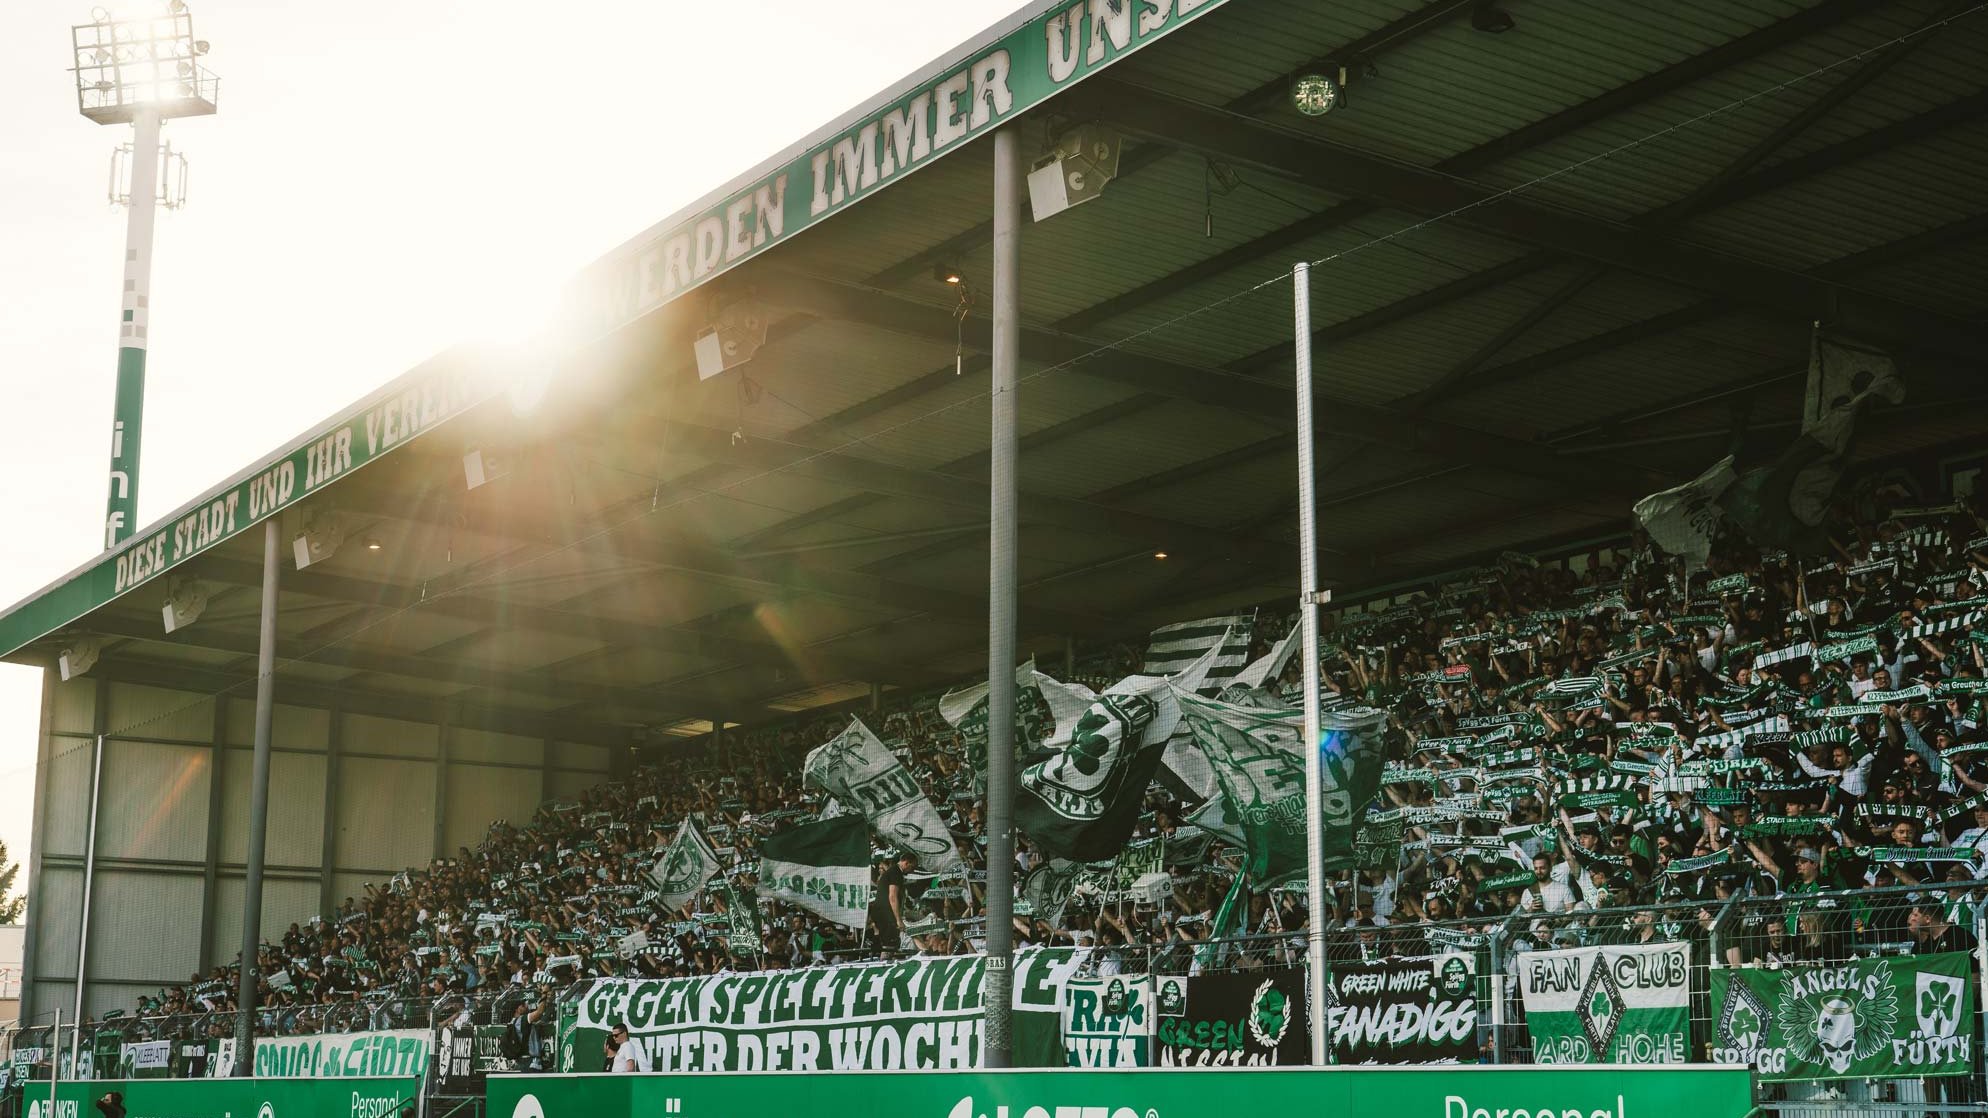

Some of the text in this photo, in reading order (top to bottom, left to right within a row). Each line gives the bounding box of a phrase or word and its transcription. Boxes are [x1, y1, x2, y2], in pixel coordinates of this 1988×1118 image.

[115, 532, 167, 594] DIESE
[173, 491, 239, 561] STADT
[248, 460, 295, 520] UND
[305, 426, 353, 491] IHR
[604, 174, 787, 325] ERDEN
[811, 46, 1013, 217] IMMER
[1045, 0, 1206, 83] UNS
[587, 948, 1076, 1029] GEGEN SPIELTERMIE
[1341, 969, 1432, 997] GREEN WHITE
[1530, 951, 1687, 993] FAN CLUB
[1158, 1017, 1245, 1053] GREEN
[1328, 998, 1476, 1052] FANADIGG
[627, 1030, 728, 1072] NTER
[738, 1030, 821, 1072] DER
[1892, 1030, 1971, 1066] FÜRTH
[41, 1099, 78, 1118] FRNKEN
